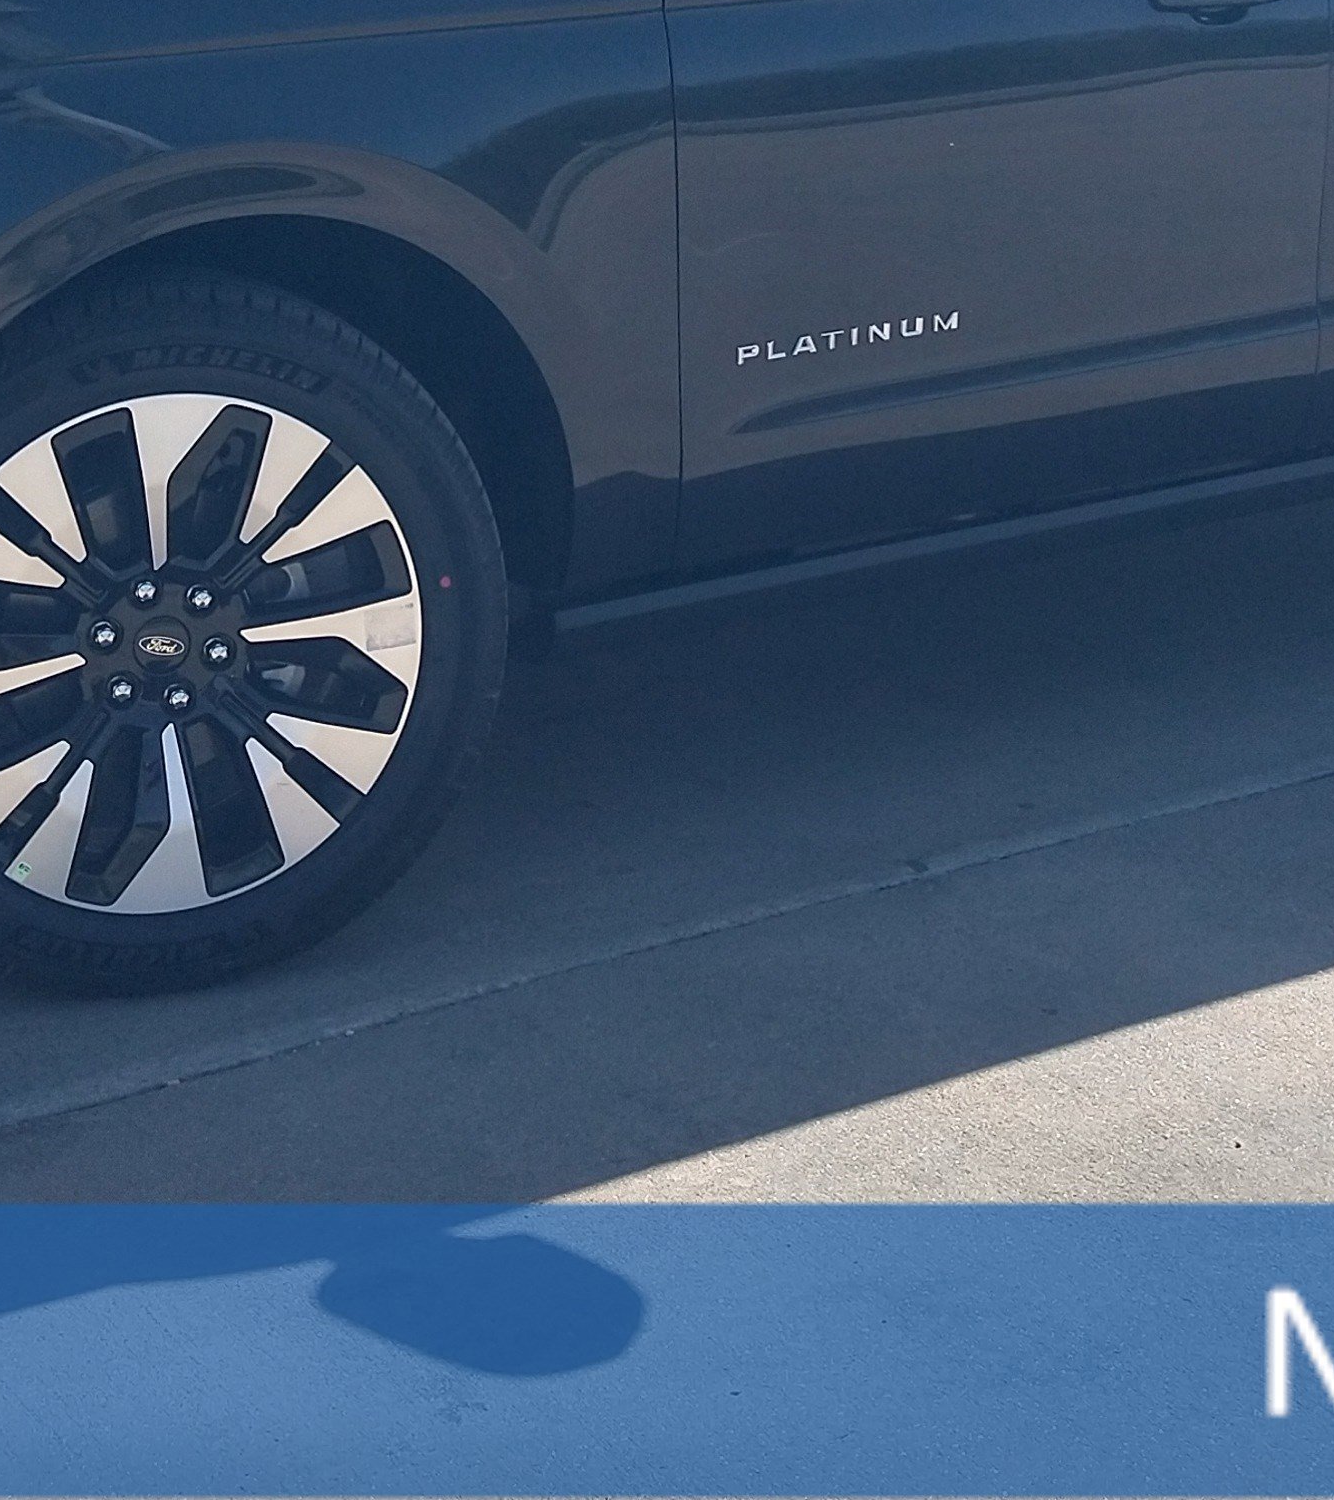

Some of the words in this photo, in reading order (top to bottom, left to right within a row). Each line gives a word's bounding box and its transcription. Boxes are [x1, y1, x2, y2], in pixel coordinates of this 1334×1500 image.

[736, 311, 961, 366] PLATINUM
[133, 345, 320, 391] MICHELIN
[146, 638, 178, 654] Ford
